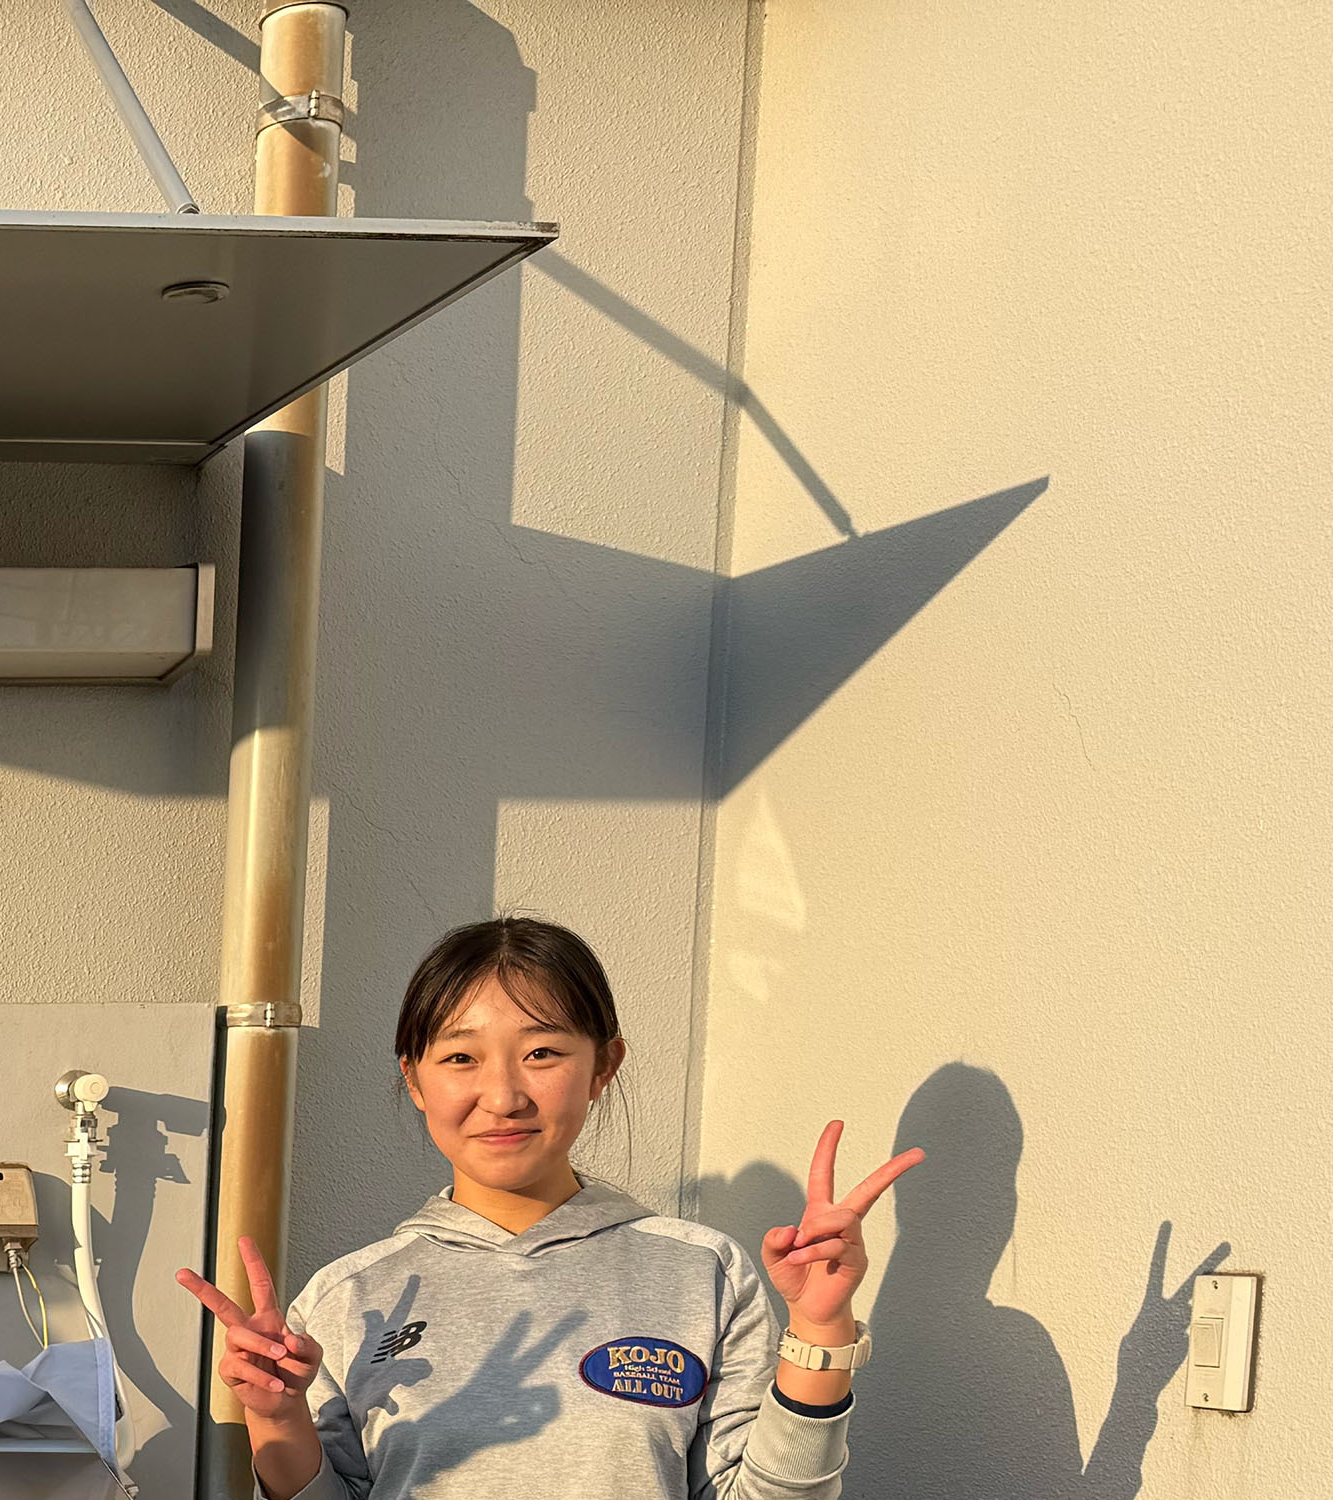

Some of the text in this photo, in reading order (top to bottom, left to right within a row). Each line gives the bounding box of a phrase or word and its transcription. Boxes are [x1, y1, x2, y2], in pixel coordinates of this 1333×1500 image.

[607, 1346, 685, 1373] KOJO
[612, 1379, 683, 1400] ALL OUT
